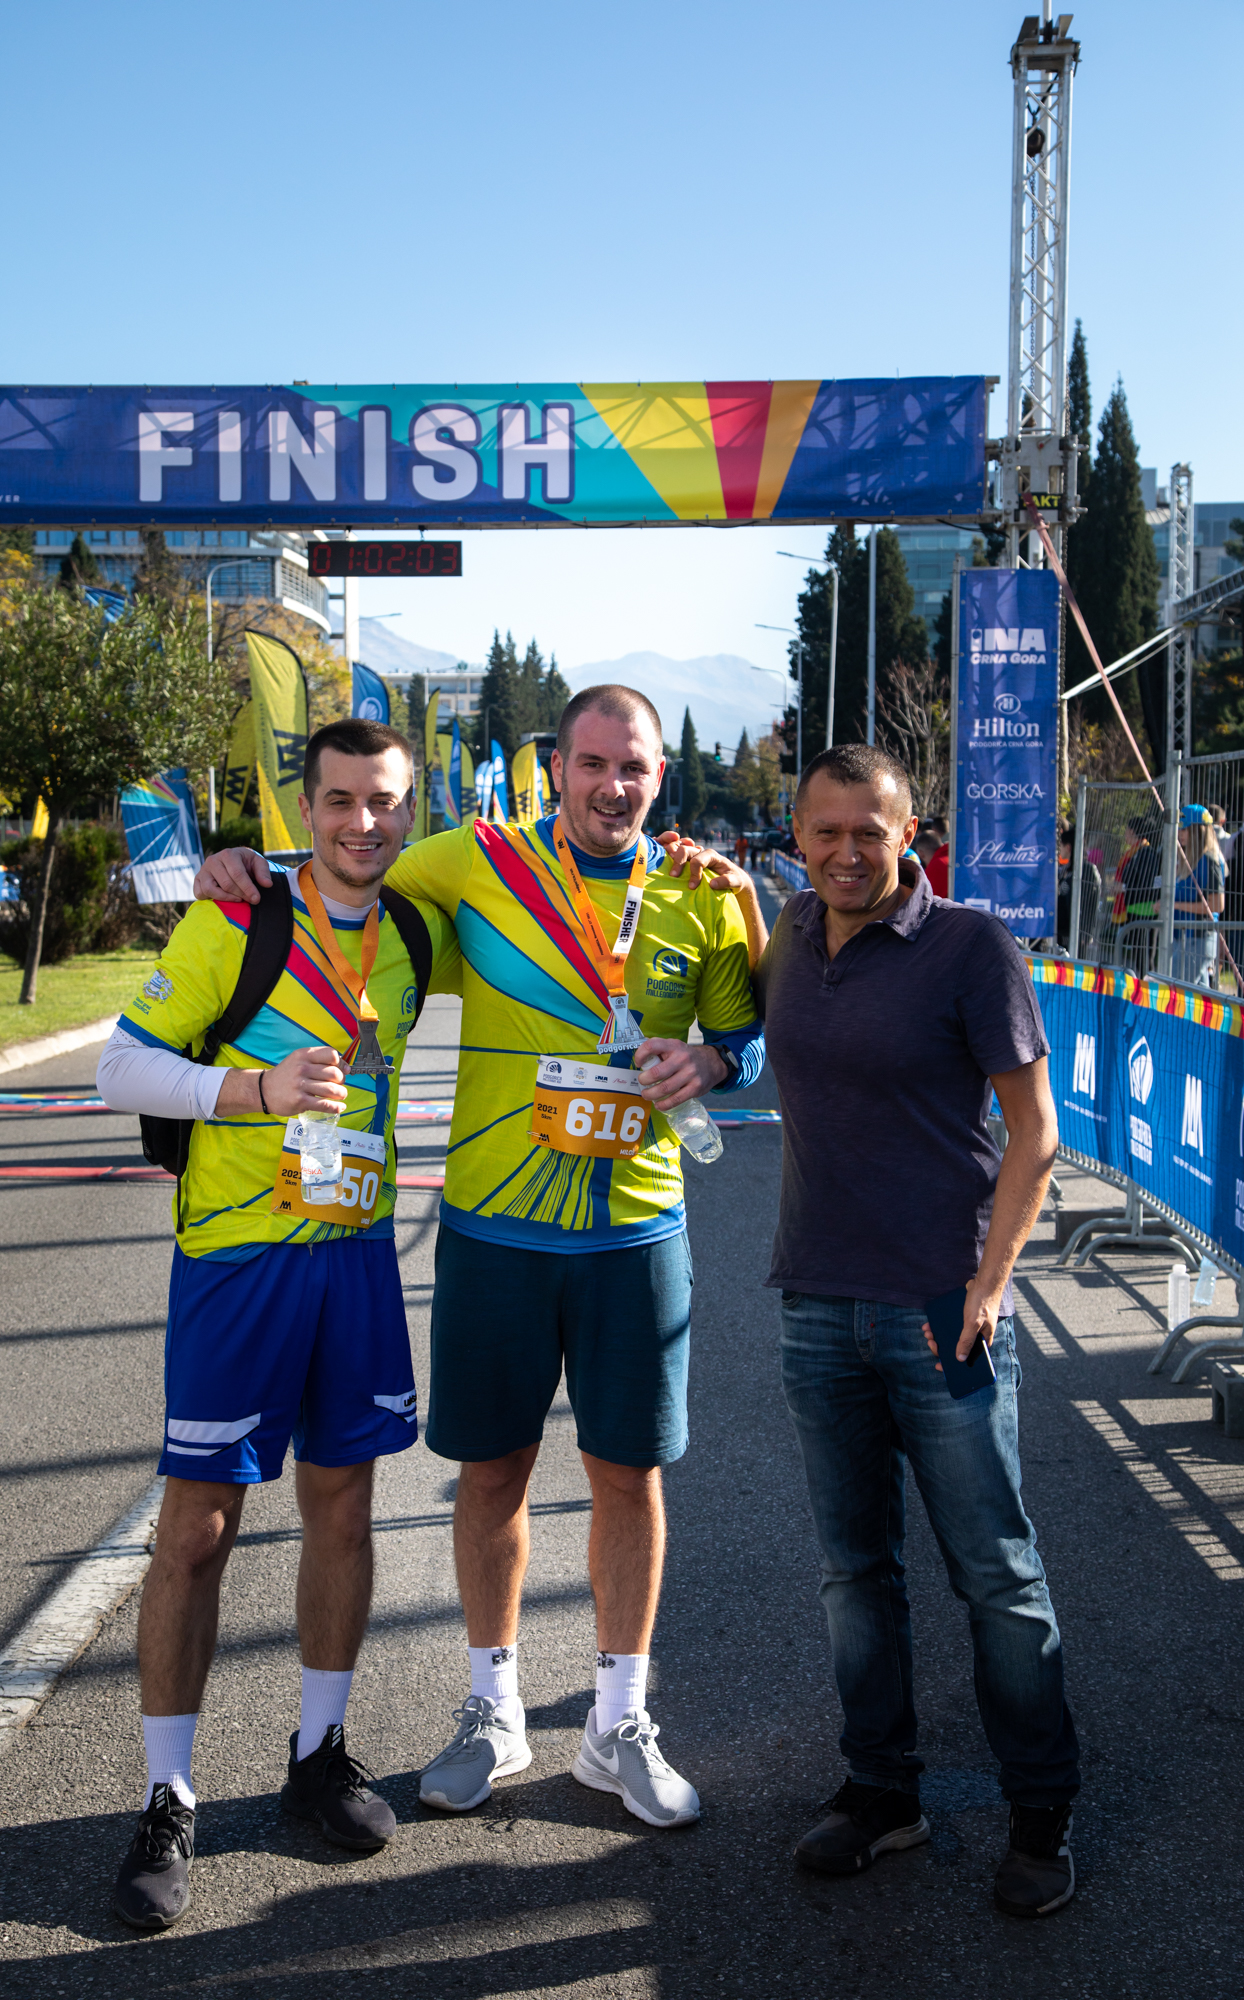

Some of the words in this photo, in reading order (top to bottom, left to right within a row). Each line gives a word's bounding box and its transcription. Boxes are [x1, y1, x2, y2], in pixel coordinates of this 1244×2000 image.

[137, 404, 575, 504] FINISH
[312, 543, 458, 574] 01:02:03
[970, 653, 1008, 665] CRNA
[1010, 653, 1047, 665] GORA
[973, 717, 1040, 737] Hilton
[969, 740, 1007, 748] PODGORICA
[1025, 740, 1044, 748] GORA
[966, 783, 1048, 800] GORSKA
[619, 900, 637, 944] FINISHER
[537, 1103, 558, 1115] 2021
[565, 1098, 645, 1143] 616
